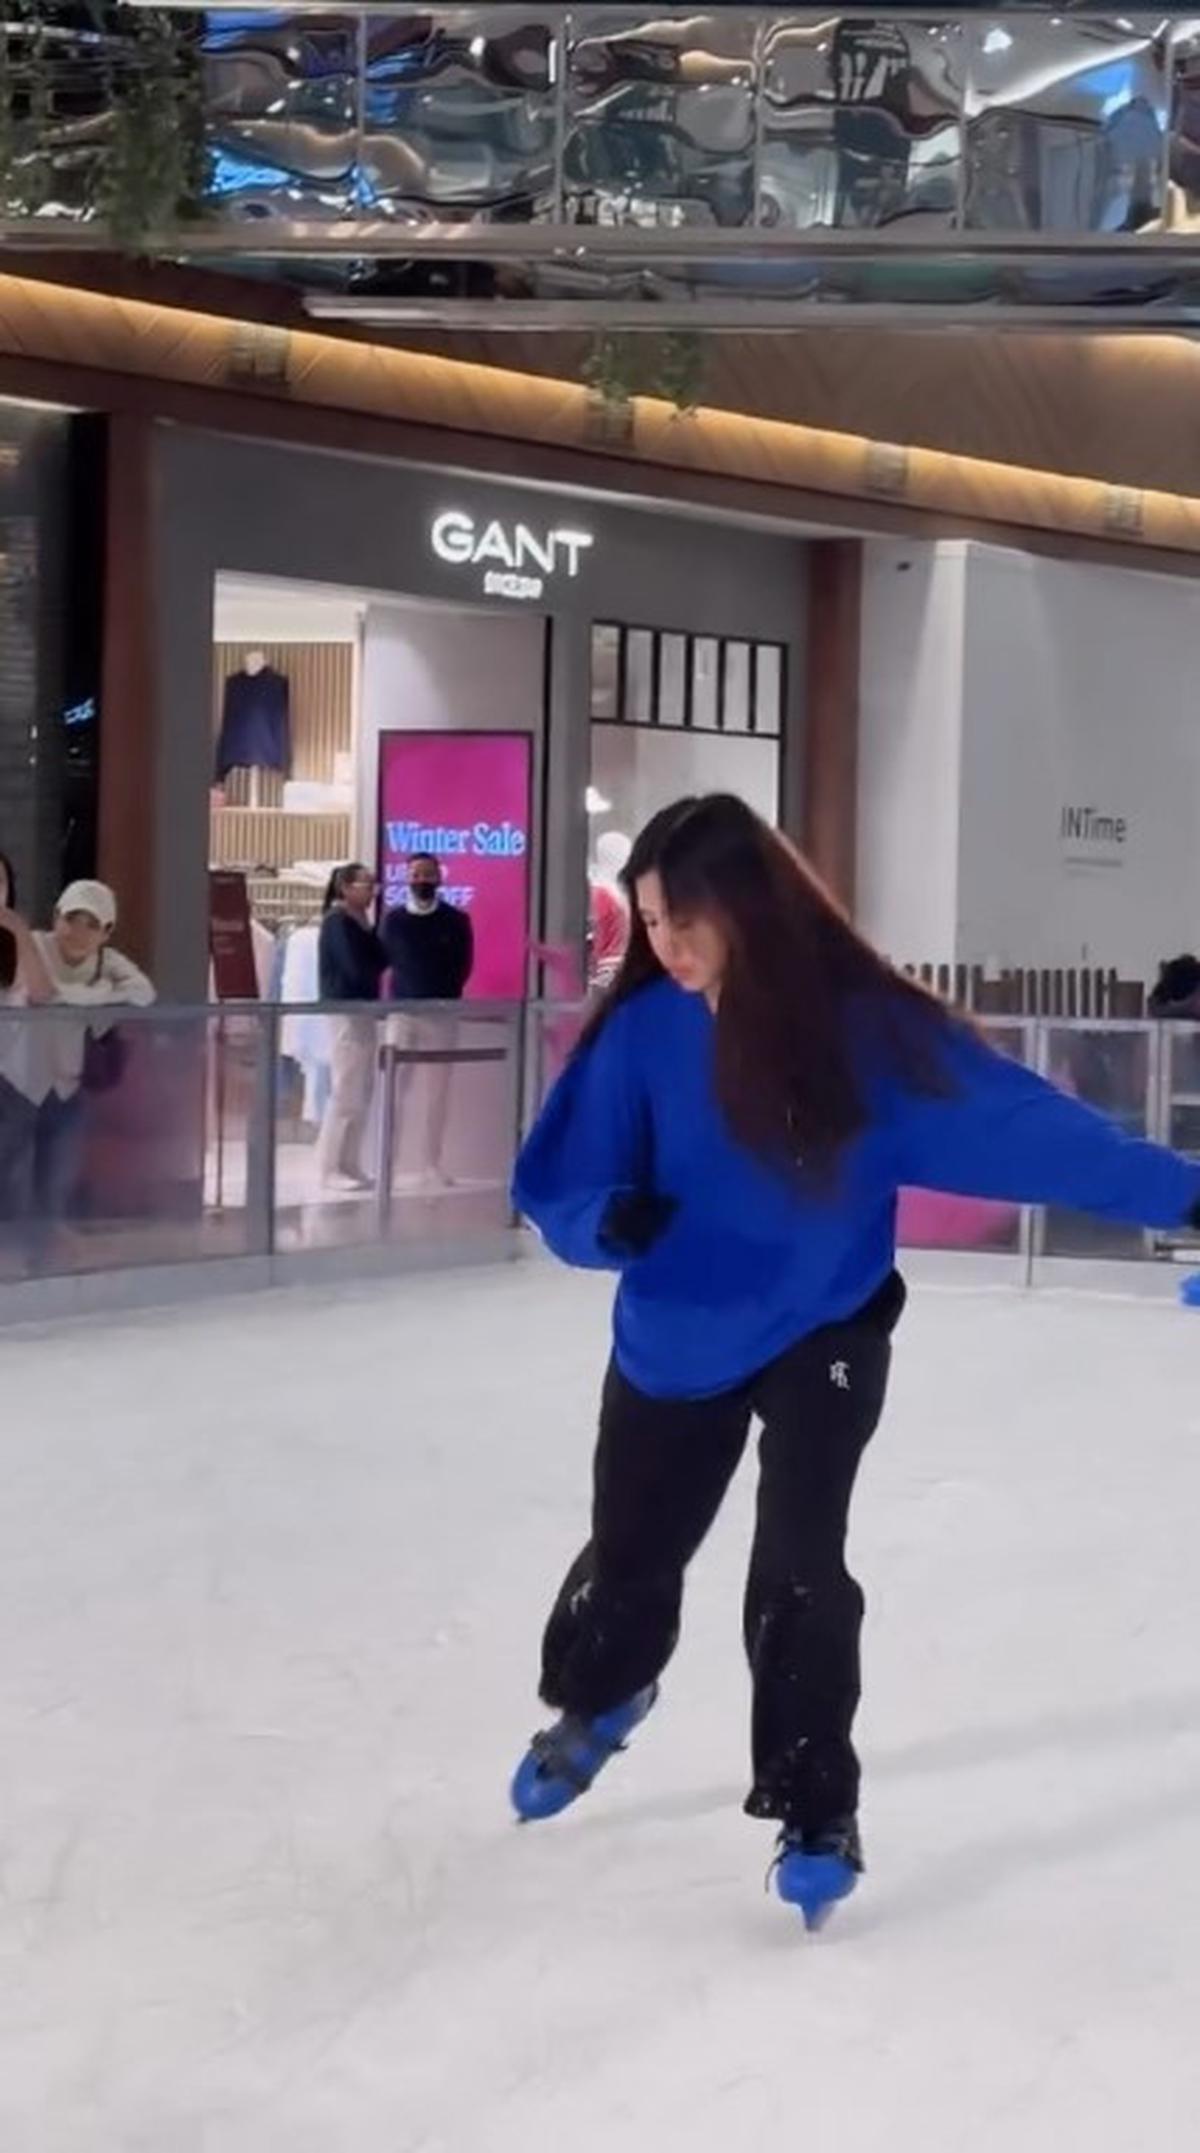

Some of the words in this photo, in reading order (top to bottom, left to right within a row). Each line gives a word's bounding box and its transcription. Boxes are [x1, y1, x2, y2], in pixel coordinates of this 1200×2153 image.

[431, 510, 594, 577] GANT
[385, 821, 469, 854] Winter
[472, 821, 526, 856] Sale
[1061, 806, 1128, 844] INTime
